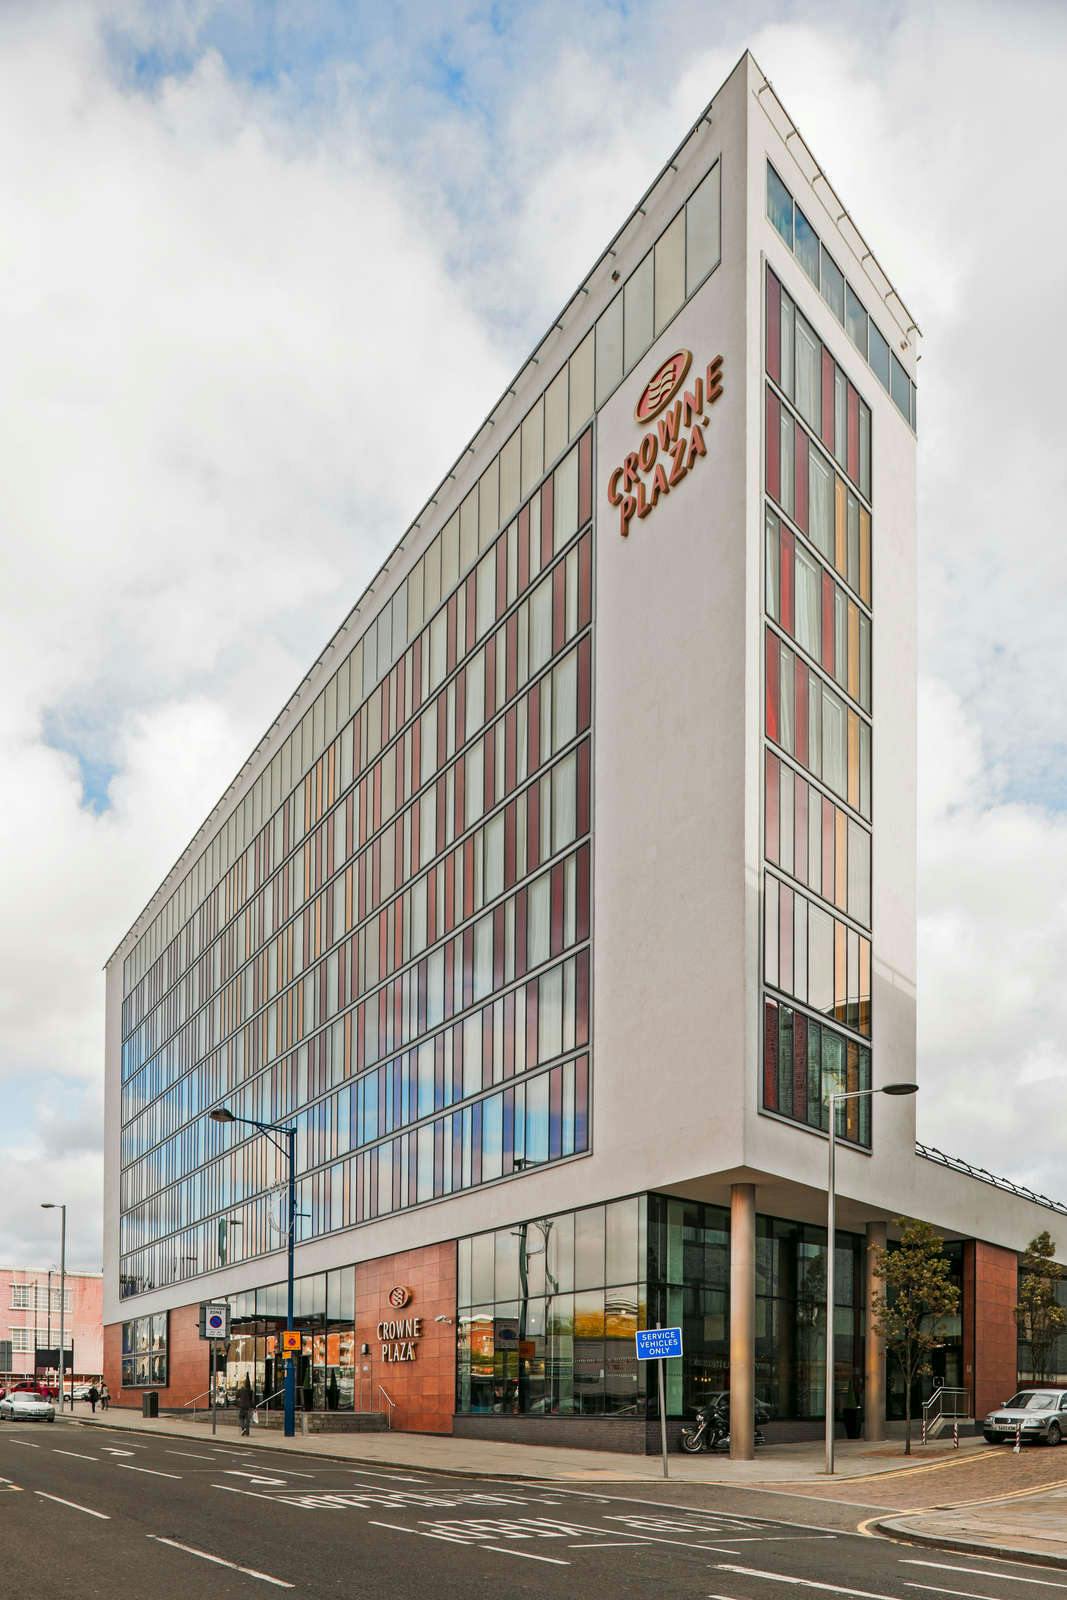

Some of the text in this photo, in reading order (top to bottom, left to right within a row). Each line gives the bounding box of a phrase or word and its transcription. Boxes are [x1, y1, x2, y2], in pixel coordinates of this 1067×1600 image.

[608, 354, 724, 506] CROWNE
[620, 424, 708, 537] PLAZA
[377, 1318, 421, 1341] CROWNE
[641, 1331, 676, 1341] SERVICE
[382, 1341, 416, 1362] PLAZA
[640, 1339, 678, 1349] VEHICLES
[649, 1347, 670, 1355] ONLY
[418, 1518, 606, 1540] KEEP
